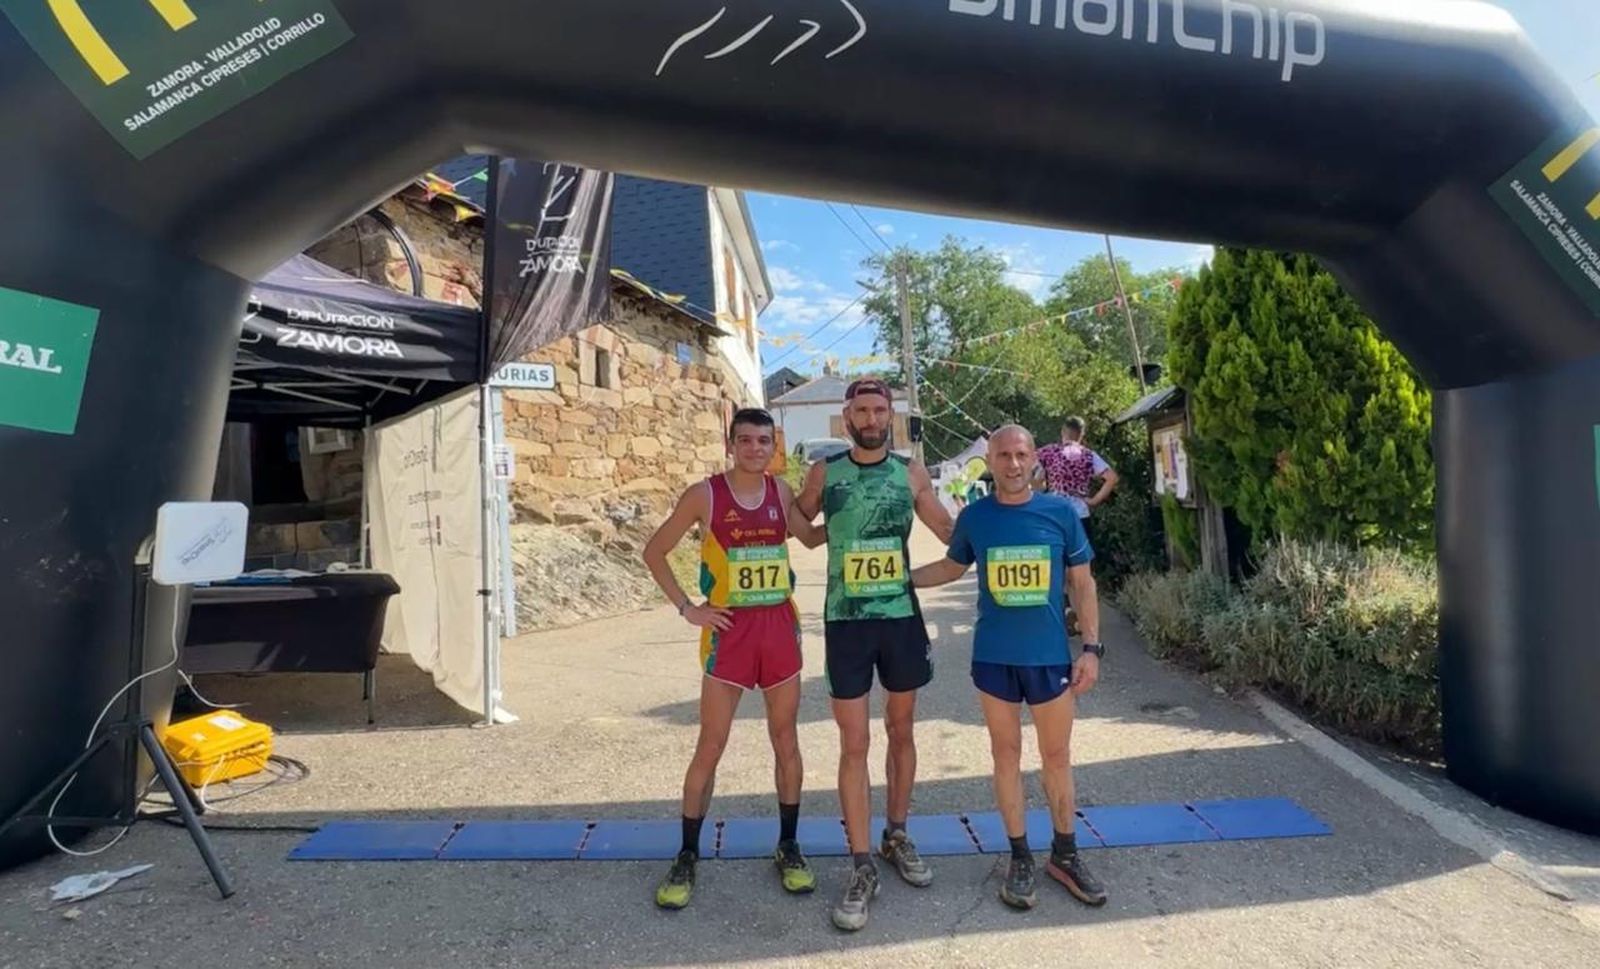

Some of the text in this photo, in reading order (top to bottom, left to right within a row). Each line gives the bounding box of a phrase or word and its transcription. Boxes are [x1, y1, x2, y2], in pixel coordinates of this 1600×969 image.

[123, 11, 327, 132] SALAMANCA CIPRESES CORRILLO
[146, 16, 282, 98] ZAMORA VALLADOLID
[1510, 180, 1551, 226] SALAMANCA
[1547, 222, 1582, 260] CIPRESES
[1536, 192, 1567, 225] ZAMORA
[276, 327, 404, 358] ZAMORA
[494, 367, 550, 382] URIAS
[739, 565, 781, 590] 817
[850, 555, 897, 580] 764
[997, 563, 1041, 588] 0191
